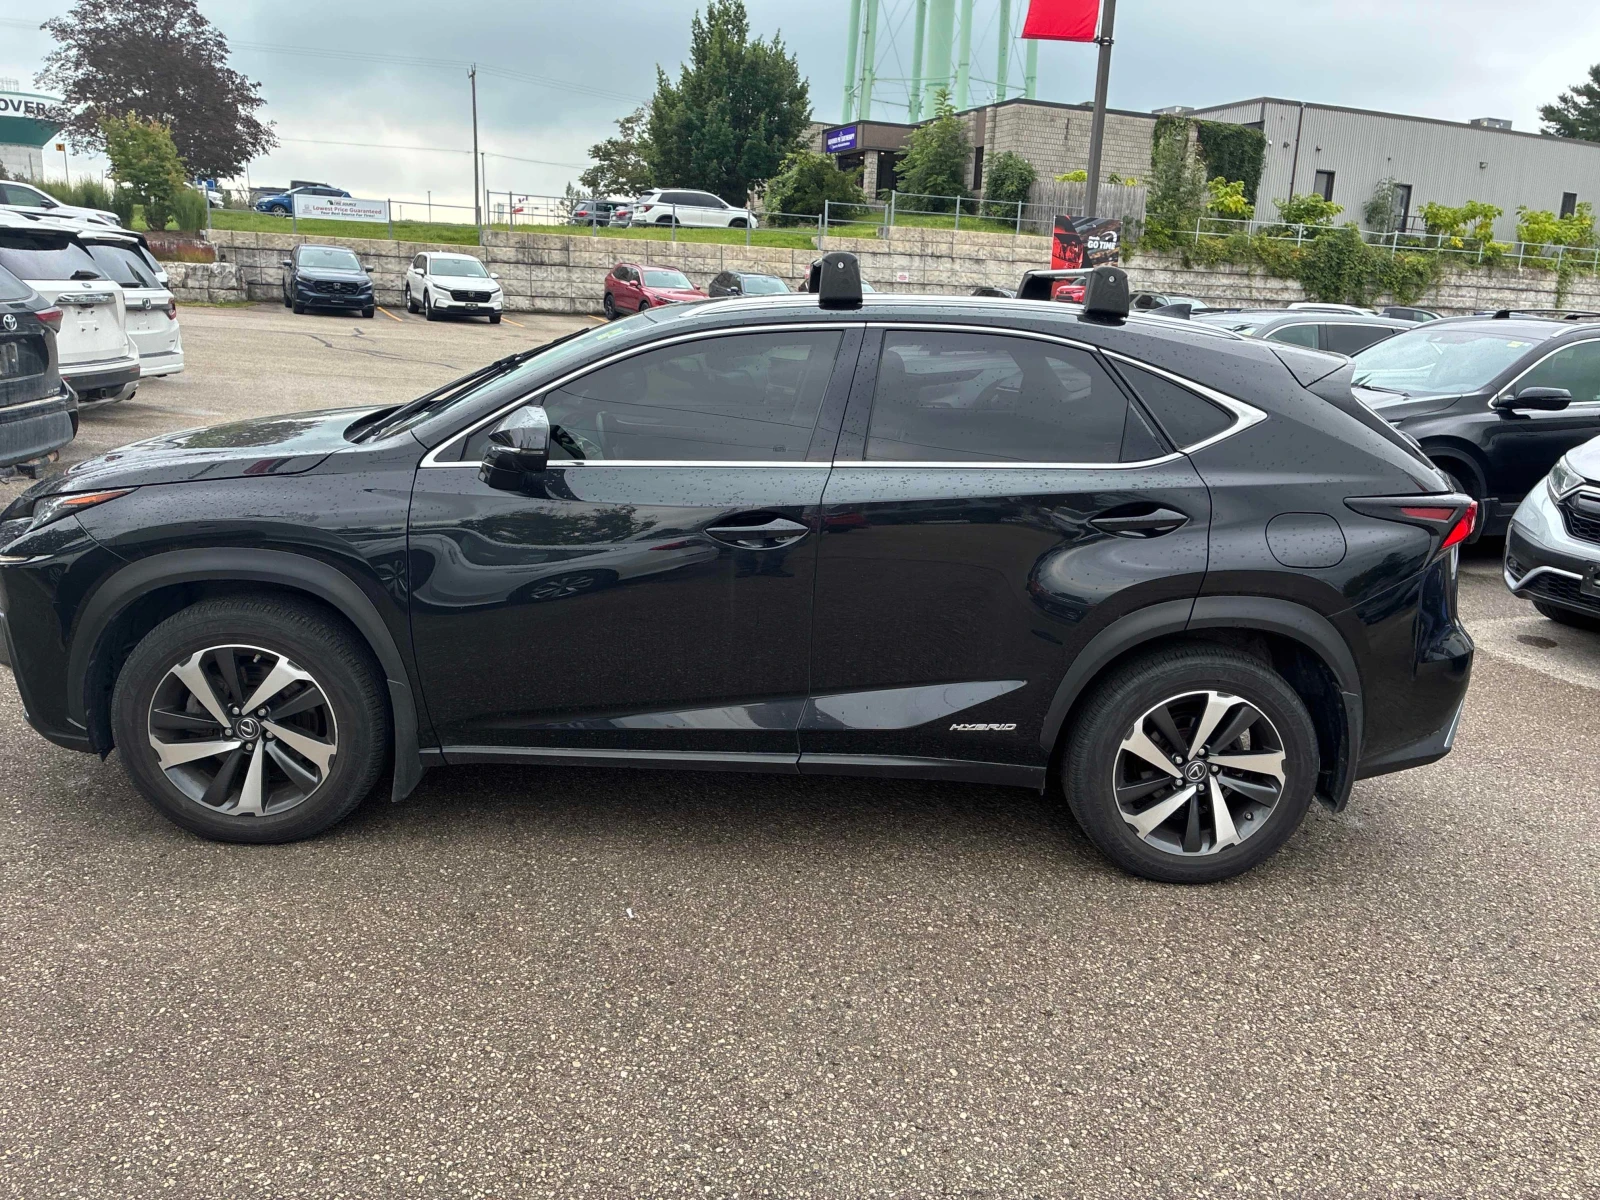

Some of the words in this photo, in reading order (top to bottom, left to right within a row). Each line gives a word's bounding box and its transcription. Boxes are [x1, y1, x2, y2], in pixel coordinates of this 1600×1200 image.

[0, 98, 46, 116] OVER
[1087, 240, 1099, 249] GO
[1099, 241, 1116, 250] TIME
[949, 723, 1017, 731] HYBRID
